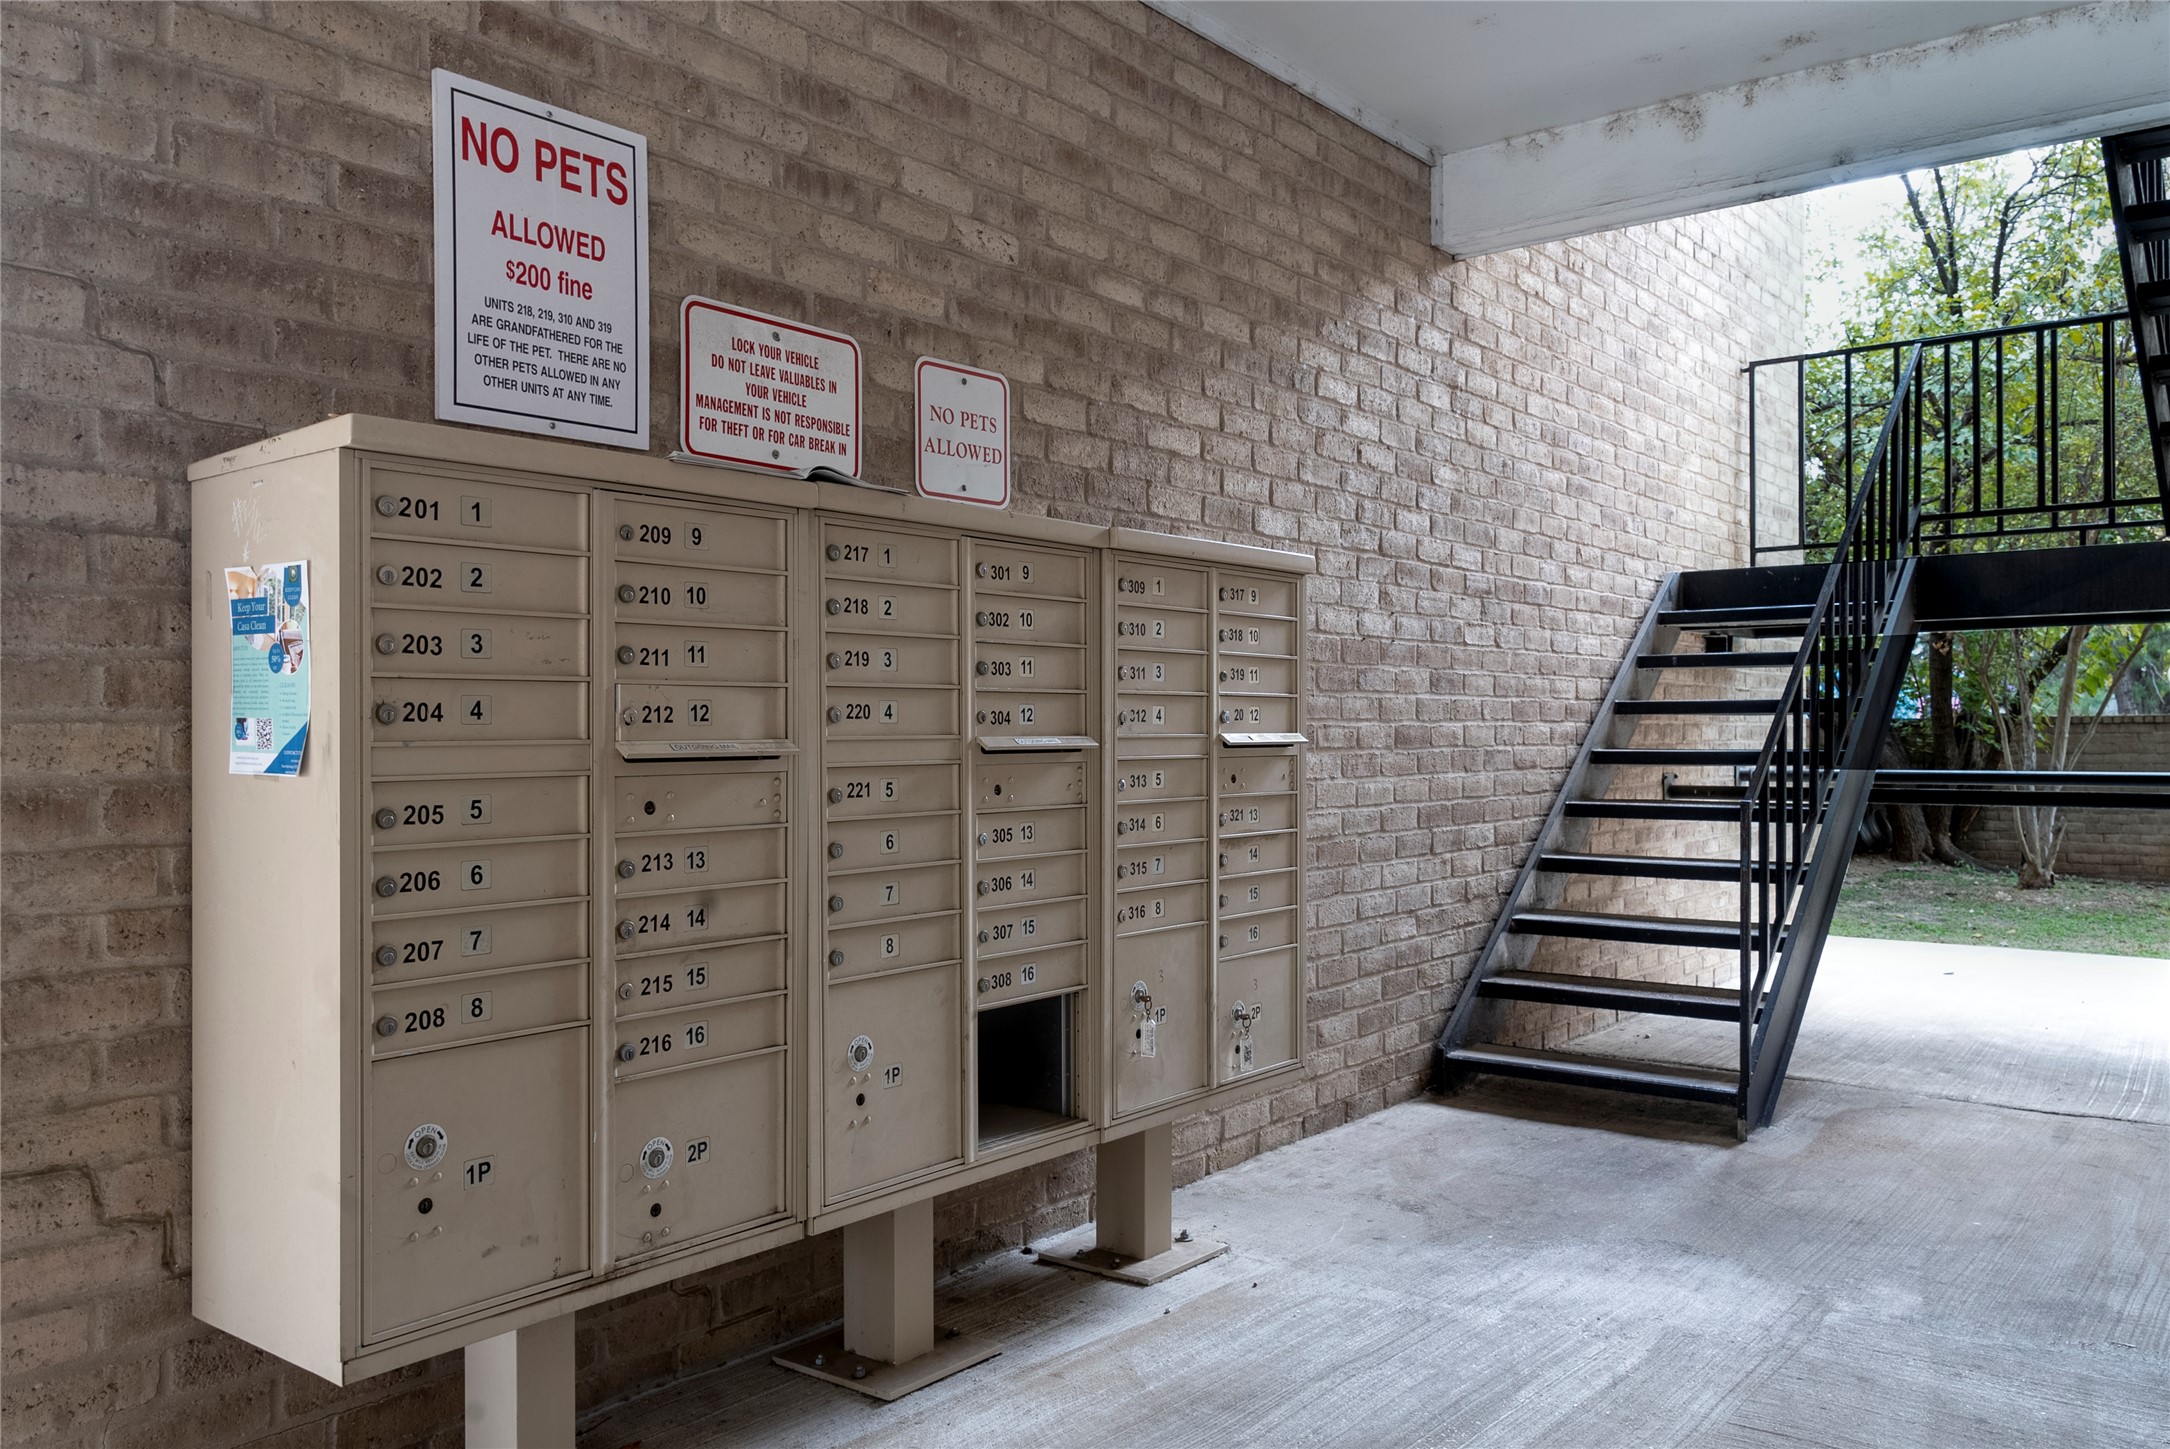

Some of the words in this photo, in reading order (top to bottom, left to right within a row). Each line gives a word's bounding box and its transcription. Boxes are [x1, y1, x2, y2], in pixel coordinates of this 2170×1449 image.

[462, 116, 519, 173] NO
[535, 139, 628, 205] PETS
[491, 210, 605, 262] ALLOWED
[506, 259, 550, 291] $200
[558, 271, 592, 300] fine
[485, 296, 514, 312] UNITS
[517, 304, 534, 318] 218,
[538, 308, 554, 323] 219,
[558, 313, 572, 325] 310
[576, 316, 595, 329] AND
[598, 321, 611, 333] 319
[472, 314, 492, 328] ARE
[496, 319, 580, 345] GRANDFATHERED
[584, 337, 602, 350] FOR
[605, 341, 622, 354] THE
[468, 332, 489, 346] LIFE
[493, 337, 506, 349] OF
[510, 341, 528, 354] THE
[533, 345, 551, 358] PET.
[558, 350, 588, 365] THERE
[592, 357, 610, 370] ARE
[614, 361, 626, 373] NO
[732, 337, 755, 355] LOCK
[759, 343, 781, 361] YOUR
[785, 350, 819, 370] VEHICLE
[475, 354, 508, 370] OTHER
[513, 361, 537, 375] PETS
[541, 366, 587, 384] ALLOWED
[590, 375, 598, 386] IN
[602, 378, 620, 390] ANY
[712, 354, 724, 368] DO
[729, 358, 746, 373] NOT
[750, 362, 775, 380] LEAVE
[779, 369, 825, 391] VALUABLES
[829, 381, 836, 394] IN
[484, 375, 517, 391] OTHER
[521, 381, 549, 396] UNITS
[553, 387, 564, 398] AT
[567, 390, 586, 402] ANY
[590, 393, 612, 407] TIME.
[745, 382, 768, 400] YOUR
[773, 388, 806, 407] VEHICLE
[696, 393, 758, 418] MANAGEMENT
[763, 407, 770, 421] IS
[775, 410, 791, 425] NOT
[795, 414, 850, 437] RESPONSIBLE
[929, 405, 954, 425] NO
[960, 411, 996, 433] PETS
[700, 416, 717, 432] FOR
[721, 420, 748, 437] THEFT
[753, 426, 764, 441] OR
[769, 429, 784, 445] FOR
[789, 433, 805, 448] CAR
[809, 437, 835, 454] BREAK
[839, 443, 846, 456] IN
[925, 438, 1002, 464] ALLOWED
[399, 497, 440, 521] 201
[472, 502, 480, 522] 1
[639, 525, 671, 545] 209
[691, 528, 701, 545] 9
[844, 545, 868, 562] 217
[884, 549, 890, 564] 1
[401, 566, 442, 588] 202
[470, 568, 483, 587] 2
[991, 566, 1010, 580] 301
[1023, 566, 1029, 579] 9
[639, 587, 671, 605] 210
[686, 587, 706, 605] 10
[1128, 581, 1145, 594] 309
[1156, 580, 1161, 593] 1
[1230, 589, 1244, 600] 317
[1251, 590, 1256, 602] 9
[238, 602, 249, 613] Keep
[252, 602, 265, 610] Your
[844, 598, 868, 614] 218
[884, 601, 892, 615] 2
[237, 622, 249, 631] Casa
[251, 621, 266, 630] Clean
[989, 613, 1009, 627] 302
[1019, 613, 1032, 627] 10
[1129, 623, 1145, 636] 310
[1156, 623, 1161, 635] 2
[1229, 630, 1243, 641] 318
[1249, 630, 1258, 642] 10
[401, 634, 442, 656] 203
[470, 634, 483, 653] 3
[640, 648, 669, 667] 211
[687, 646, 705, 663] 11
[845, 651, 869, 666] 219
[884, 653, 892, 667] 3
[991, 662, 1011, 676] 303
[1021, 660, 1032, 674] 11
[1130, 667, 1145, 679] 311
[1156, 666, 1161, 678] 3
[1231, 669, 1244, 680] 319
[1250, 669, 1258, 681] 11
[403, 702, 443, 722] 204
[470, 701, 483, 720] 4
[642, 706, 673, 724] 212
[690, 704, 709, 722] 12
[846, 704, 870, 720] 220
[884, 705, 892, 719] 4
[991, 711, 1011, 725] 304
[1020, 708, 1033, 722] 12
[1130, 710, 1146, 722] 312
[1156, 709, 1161, 721] 4
[1250, 709, 1258, 720] 12
[1130, 775, 1146, 787] 313
[1156, 773, 1161, 786] 5
[847, 783, 871, 798] 221
[885, 782, 893, 798] 5
[403, 805, 444, 825] 205
[470, 800, 482, 819] 5
[1230, 809, 1243, 821] 321
[1249, 809, 1258, 821] 13
[1129, 818, 1146, 831] 314
[1156, 816, 1161, 829] 6
[886, 834, 894, 849] 6
[992, 828, 1012, 842] 305
[1020, 826, 1033, 840] 13
[641, 853, 673, 873] 213
[687, 851, 706, 869] 13
[1249, 848, 1257, 860] 14
[1130, 862, 1147, 875] 315
[1156, 859, 1161, 871] 7
[400, 871, 440, 893] 206
[470, 865, 483, 885] 6
[992, 877, 1012, 891] 306
[1021, 873, 1033, 887] 14
[886, 886, 893, 901] 7
[1250, 887, 1258, 899] 15
[1129, 905, 1145, 919] 316
[1156, 902, 1161, 914] 8
[638, 914, 670, 933] 214
[686, 910, 706, 927] 14
[992, 925, 1013, 940] 307
[1022, 920, 1035, 934] 15
[1249, 927, 1257, 939] 16
[403, 940, 444, 963] 207
[470, 931, 482, 951] 7
[886, 938, 894, 953] 8
[640, 975, 673, 996] 215
[687, 968, 706, 985] 15
[992, 973, 1012, 988] 308
[1022, 967, 1034, 981] 16
[404, 1009, 445, 1032] 208
[470, 998, 483, 1017] 8
[1155, 1008, 1165, 1022] 1P
[1252, 1007, 1260, 1019] 2P
[640, 1034, 672, 1055] 216
[686, 1026, 705, 1044] 16
[885, 1067, 900, 1086] 1P
[414, 1126, 437, 1138] OPEN
[647, 1139, 665, 1150] OPEN
[688, 1141, 708, 1163] 2P
[465, 1163, 491, 1185] 1P
